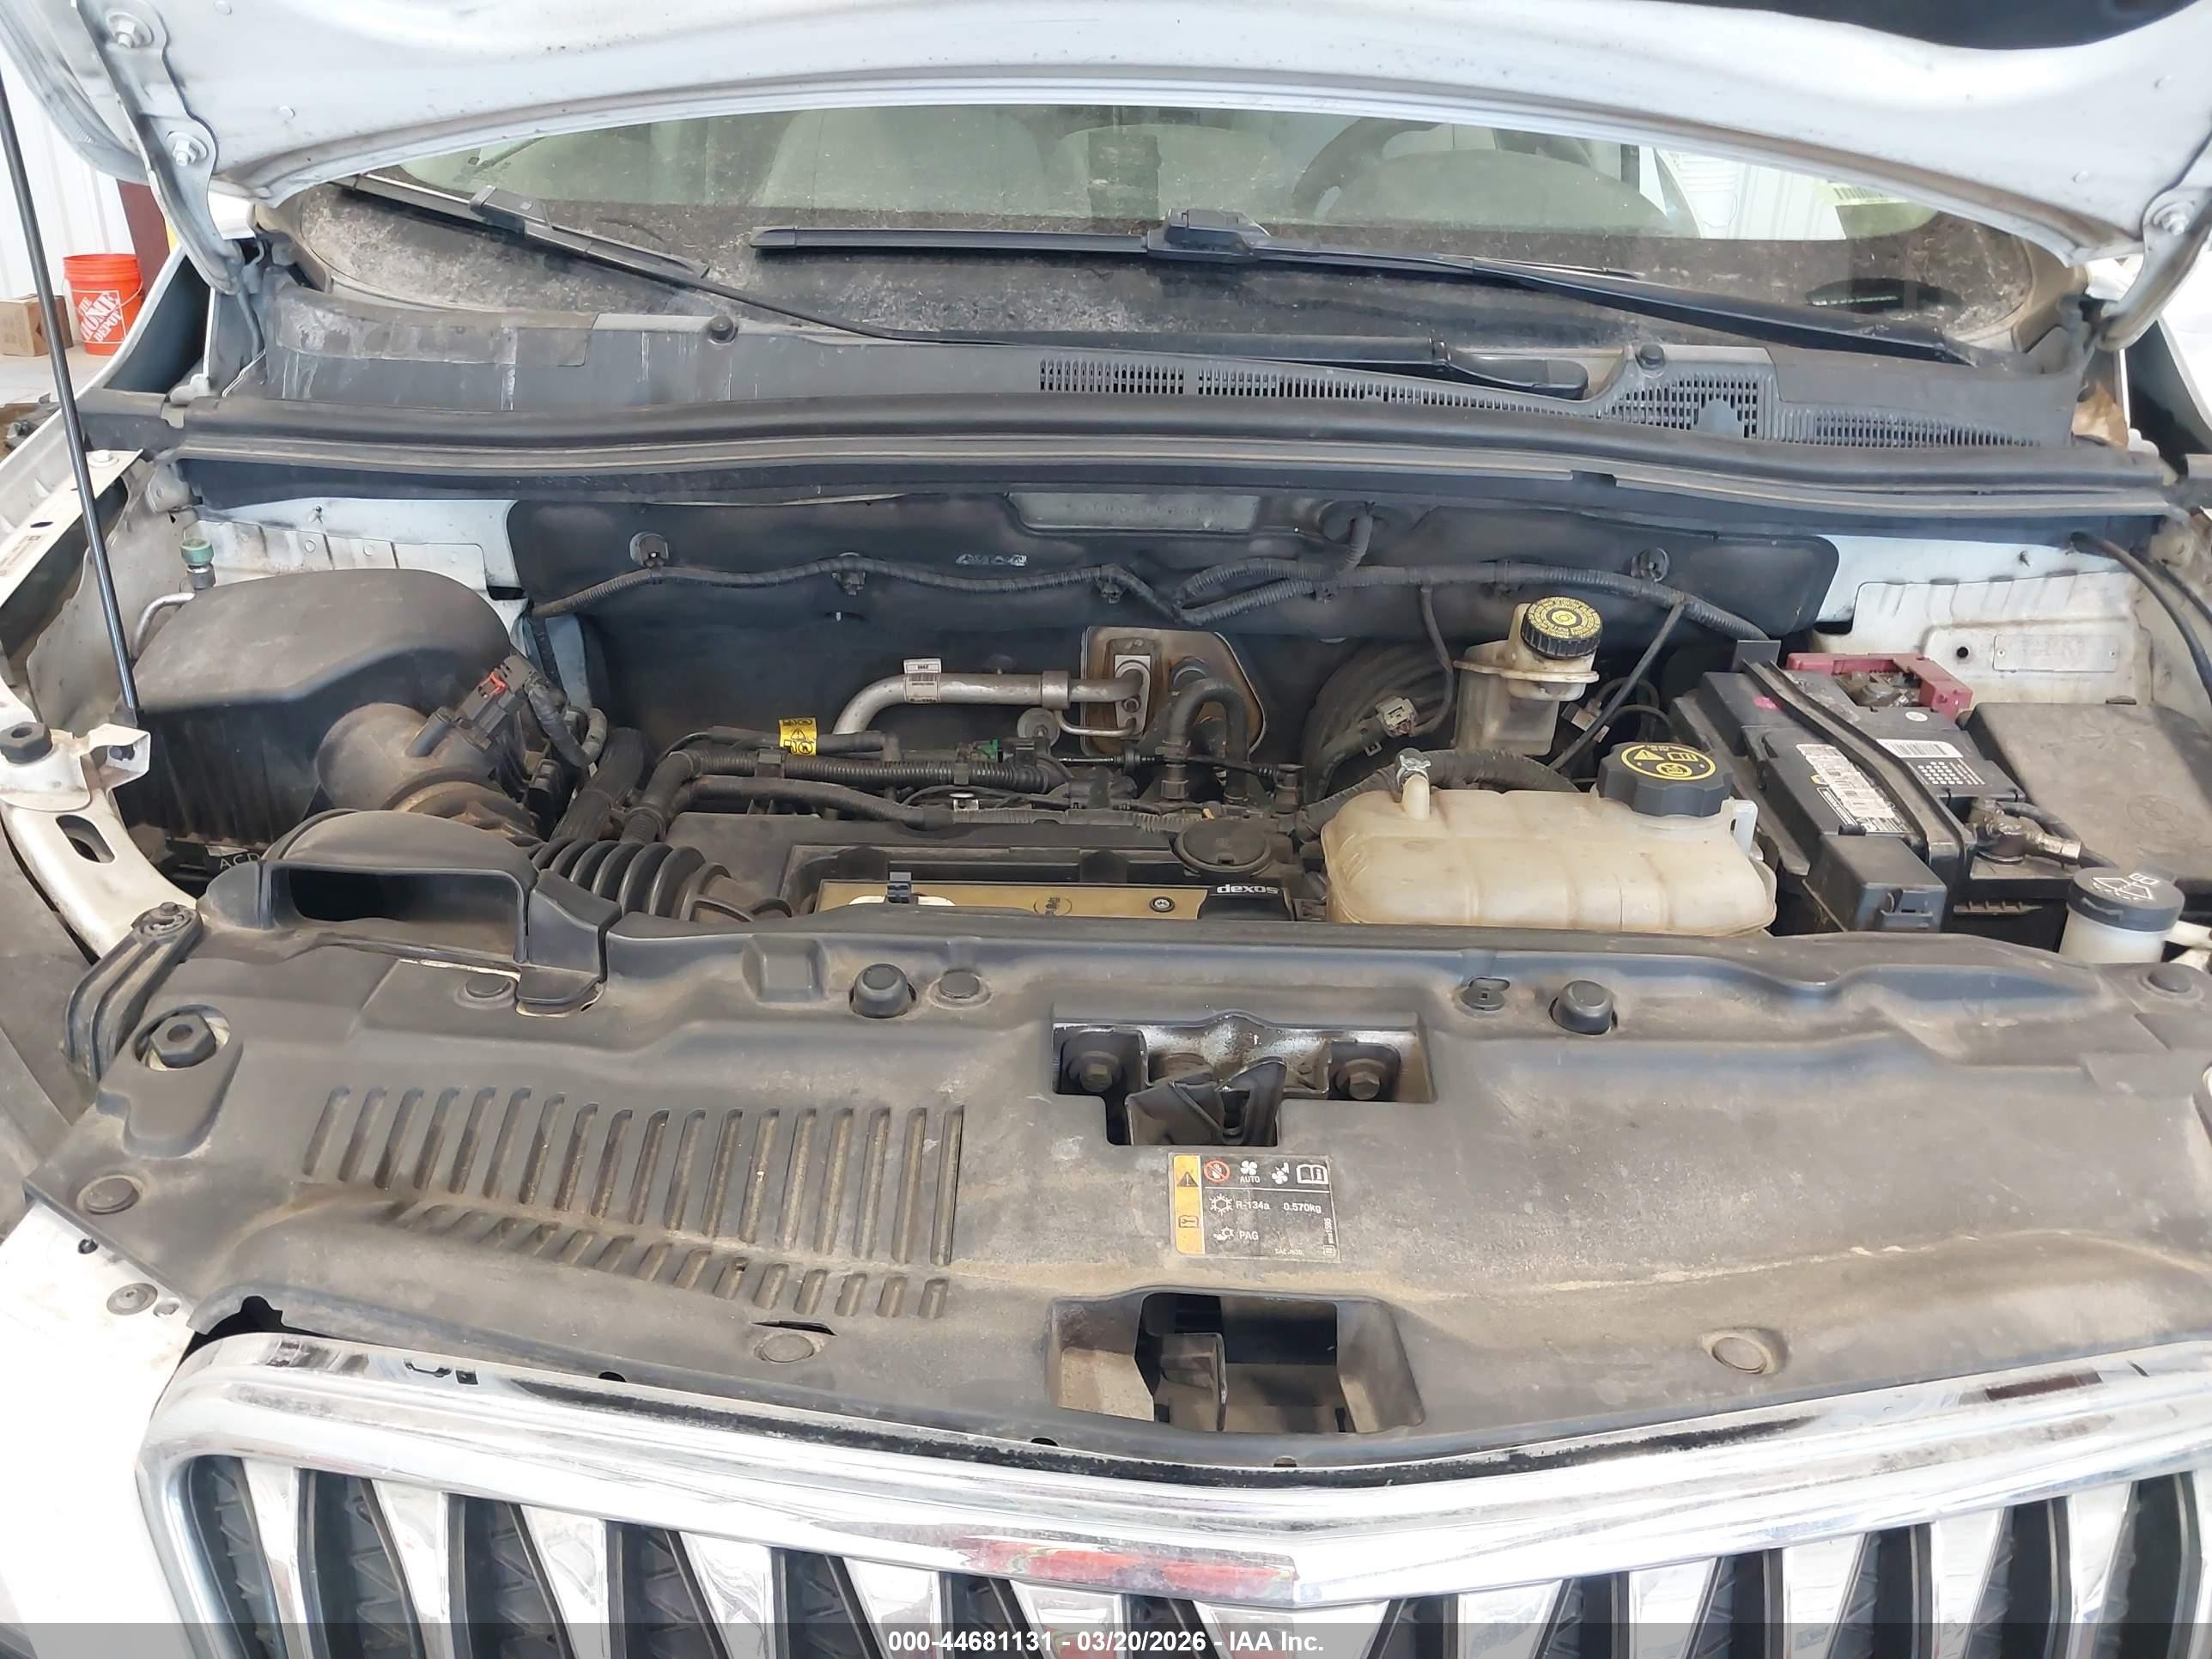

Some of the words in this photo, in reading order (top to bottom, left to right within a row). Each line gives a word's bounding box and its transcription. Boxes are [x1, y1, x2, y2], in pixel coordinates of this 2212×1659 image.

[77, 296, 93, 316] THE
[81, 291, 118, 342] HOME
[94, 309, 122, 343] DEPOT
[1216, 884, 1279, 894] dexos
[1236, 1200, 1271, 1210] R-134a
[1283, 1202, 1322, 1214] 0.570kg
[1239, 1230, 1259, 1241] PAG
